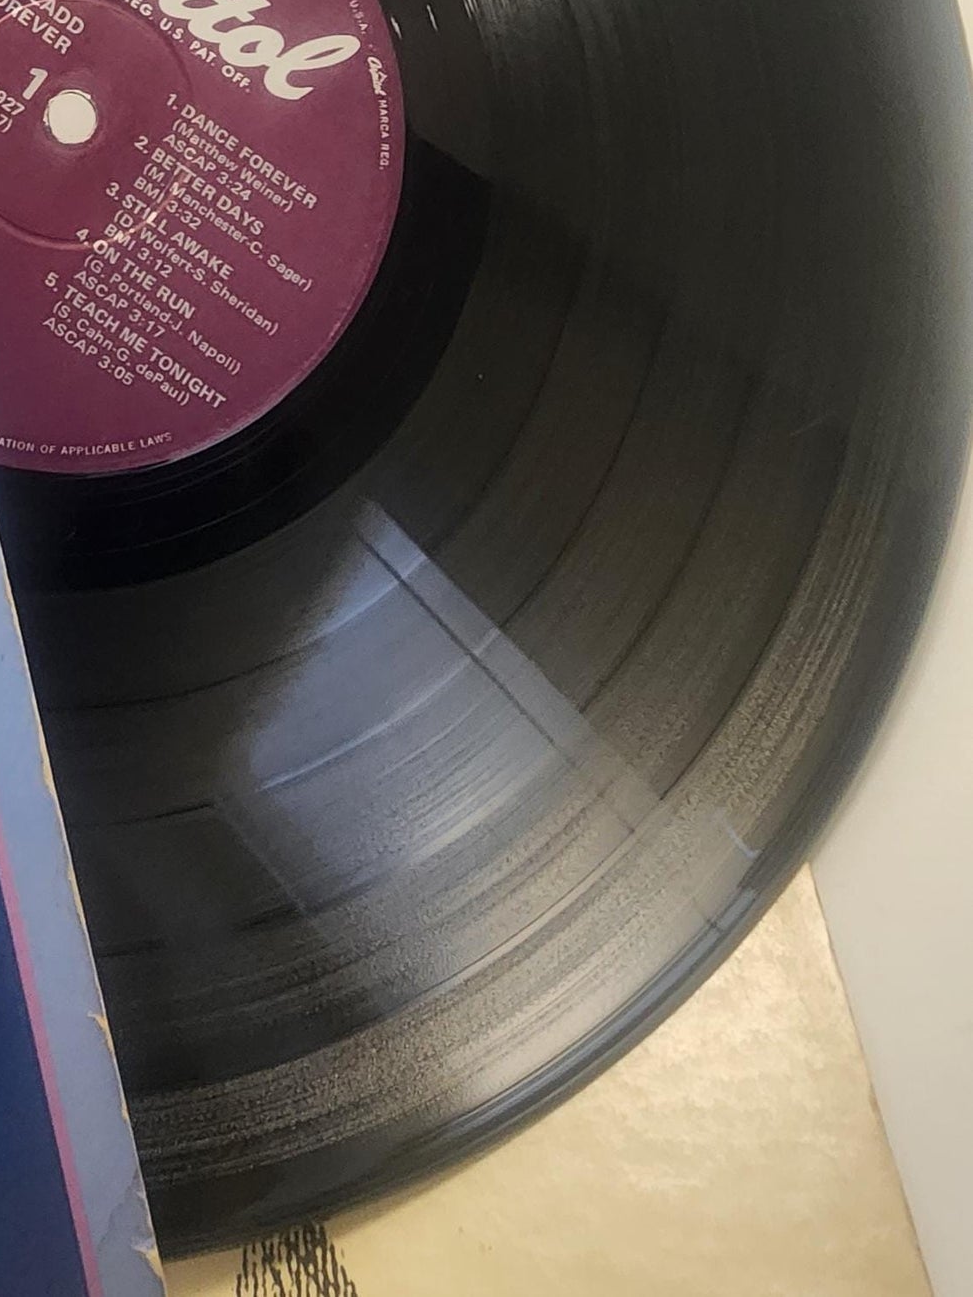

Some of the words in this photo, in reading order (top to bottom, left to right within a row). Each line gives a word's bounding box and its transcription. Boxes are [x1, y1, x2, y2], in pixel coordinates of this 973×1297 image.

[22, 68, 49, 100] 1
[159, 18, 185, 43] U.S.
[189, 40, 217, 67] PAT.
[221, 65, 251, 93] OFF.
[166, 93, 178, 111] 1.
[180, 103, 239, 152] DANCE
[238, 146, 318, 210] FOREVER
[378, 99, 389, 139] MARCA
[379, 143, 390, 170] REG.
[133, 135, 149, 154] 2.
[151, 147, 217, 201] BETTER
[216, 195, 264, 235] DAYS
[133, 176, 165, 204] BMI
[166, 200, 202, 230] 3:32
[162, 133, 217, 172] ASCAP
[216, 172, 252, 201] 3:24
[172, 119, 239, 172] (Matthew
[239, 166, 294, 213] Weiner)
[104, 223, 136, 251] BMI
[137, 247, 173, 278] 3:12
[106, 182, 120, 200] 3.
[122, 194, 167, 235] STILL
[170, 231, 234, 280] AWAKE
[143, 163, 165, 187] (M.
[169, 182, 263, 259] Manchester-C.
[267, 254, 313, 292] Sager)
[74, 270, 128, 310] ASCAP
[128, 308, 166, 338] 3:17
[75, 228, 89, 246] 4.
[92, 239, 121, 264] ON
[122, 258, 157, 291] THE
[156, 286, 195, 319] RUN
[113, 209, 135, 234] (D.
[140, 227, 206, 286] Wolfert-S.
[209, 280, 279, 336] Sheridan)
[42, 317, 99, 357] ASCAP
[97, 356, 135, 386] 3:05
[44, 271, 60, 292] 5.
[64, 284, 120, 333] TEACH
[119, 327, 148, 354] ME
[148, 347, 227, 409] TONIGHT
[52, 301, 72, 323] (S.
[76, 318, 132, 366] Cahn-G.
[135, 362, 190, 407] dePaul)
[84, 254, 106, 278] (G.
[109, 273, 183, 336] Portland-J.
[187, 330, 241, 376] Napoli)
[40, 444, 56, 454] OF
[60, 441, 136, 456] APPLICABLE
[139, 432, 172, 449] LAWS
